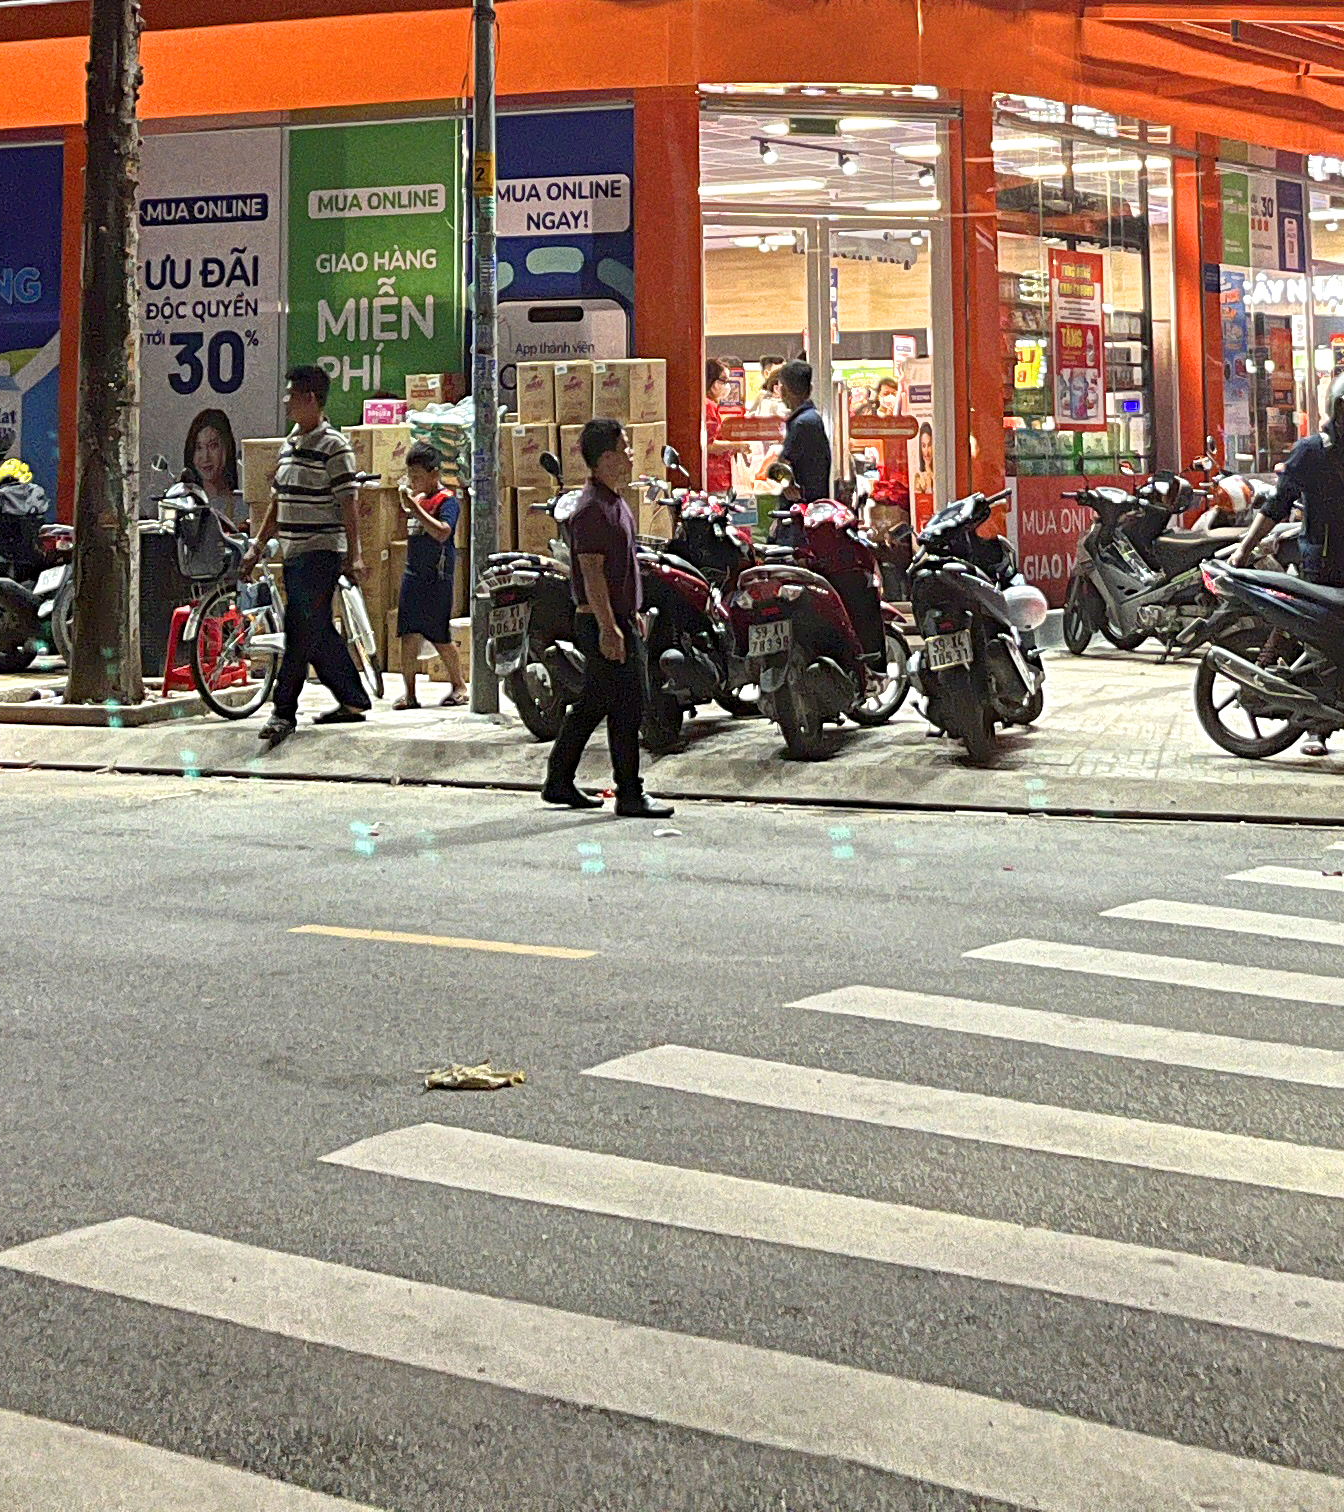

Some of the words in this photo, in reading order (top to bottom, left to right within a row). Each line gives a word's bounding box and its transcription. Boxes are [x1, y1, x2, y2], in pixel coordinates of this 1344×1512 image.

[317, 193, 363, 214] MUA
[367, 189, 439, 210] ONLINE
[546, 180, 622, 201] ONLINE
[146, 201, 190, 222] MUA
[193, 197, 263, 219] ONLINE
[526, 210, 589, 231] NGAY!
[145, 253, 192, 291] ƯU
[199, 246, 259, 288] ĐÃI
[316, 251, 368, 273] GIAO
[373, 244, 437, 271] HÀNG
[145, 296, 187, 324] ĐỘC
[317, 276, 434, 342] MIỄN
[515, 342, 539, 356] App
[1022, 508, 1058, 536] MUA
[1023, 553, 1062, 581] GIAO
